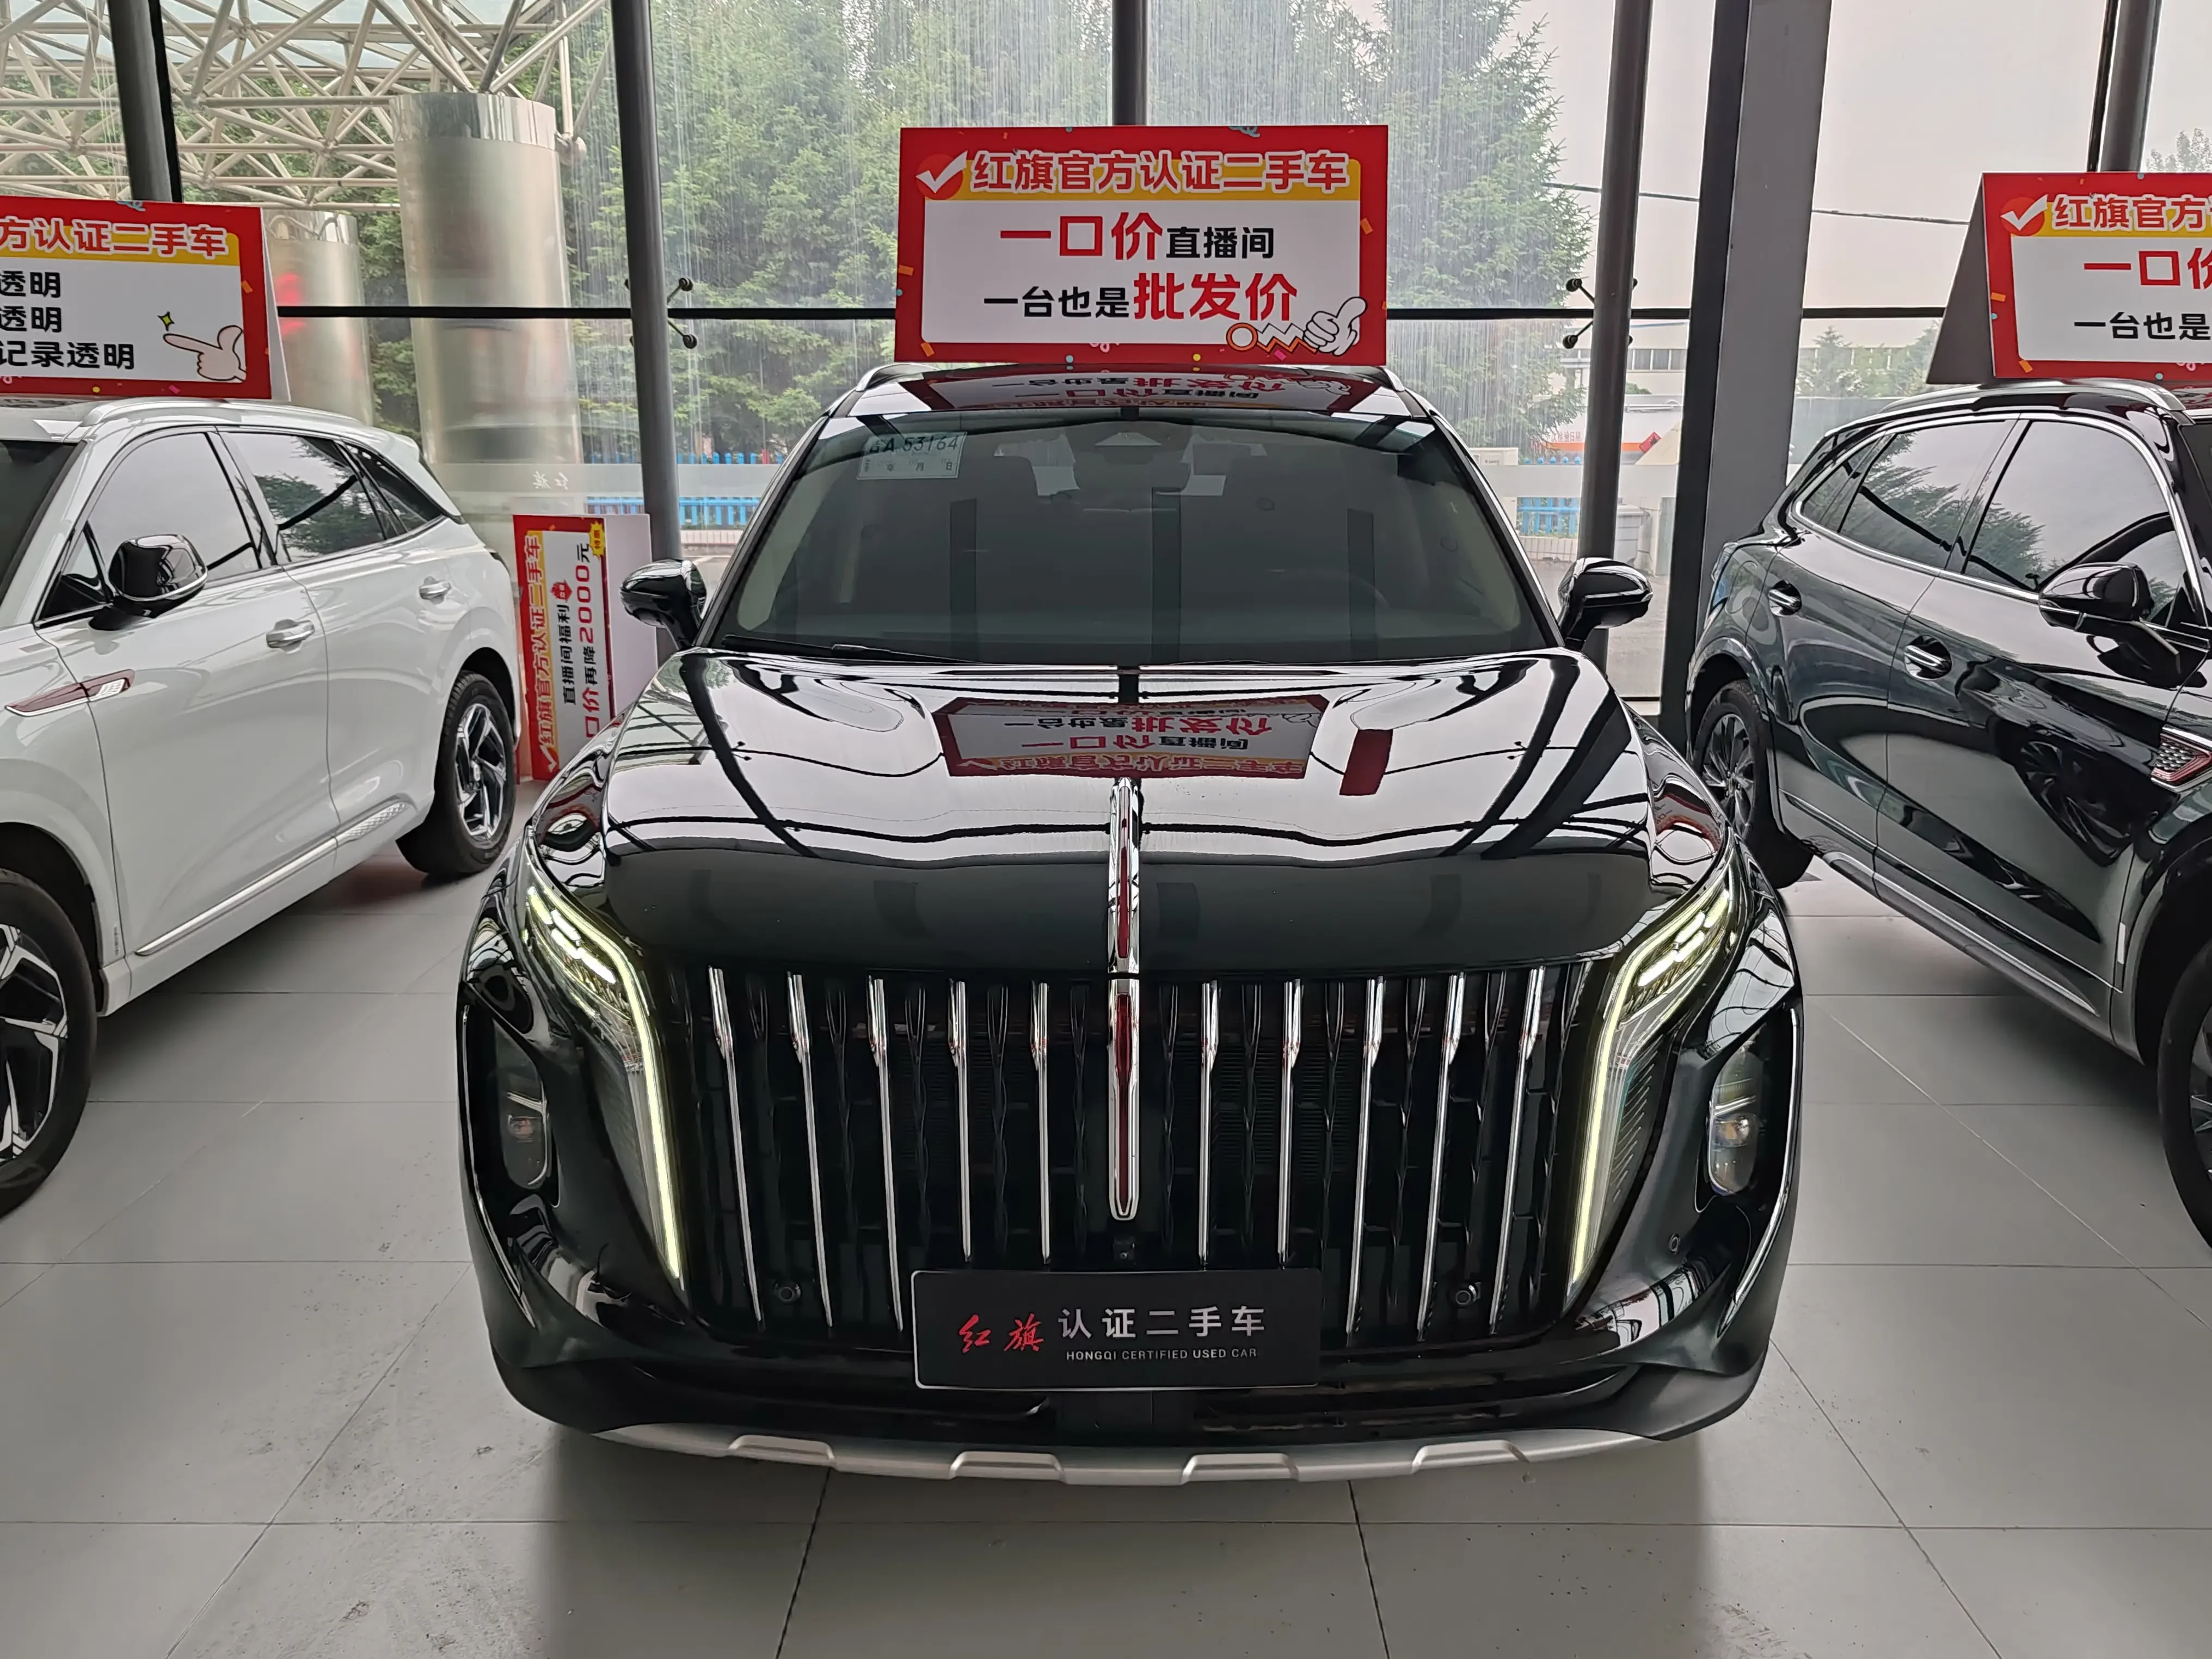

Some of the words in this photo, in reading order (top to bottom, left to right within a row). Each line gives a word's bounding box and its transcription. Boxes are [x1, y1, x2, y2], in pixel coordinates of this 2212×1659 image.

[972, 151, 1348, 192] 红旗官方认证二手车
[2054, 196, 2212, 229] 红旗官方
[0, 219, 226, 257] 方认证二手车
[1000, 212, 1274, 261] 一口价直播间
[984, 272, 1298, 322] 一台也是批发价
[2074, 312, 2211, 341] 一台也是
[0, 340, 135, 370] 记录透明
[525, 535, 555, 745] 红旗官方认证二手车
[556, 605, 576, 706] 直播间福利
[1066, 1350, 1117, 1360] HONGQI
[1122, 1349, 1188, 1360] CERTIFIED
[1193, 1349, 1227, 1359] USED
[1231, 1348, 1257, 1358] CAR
